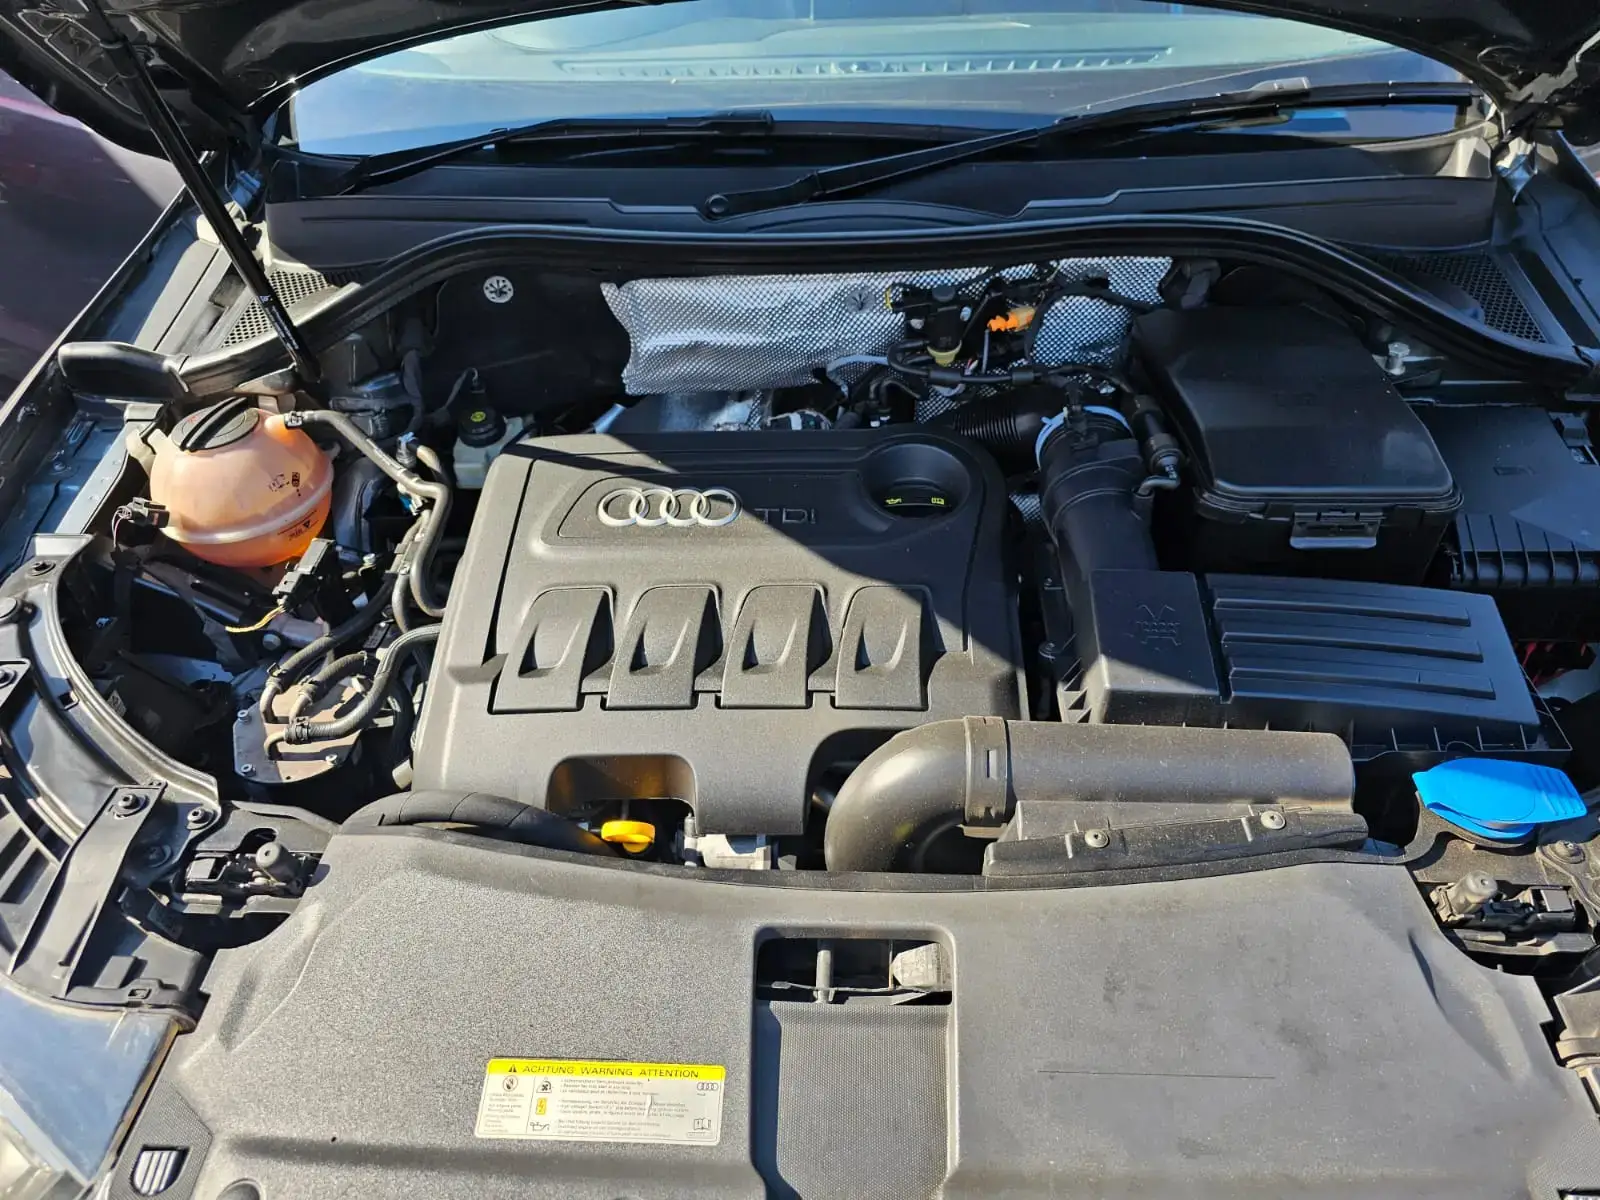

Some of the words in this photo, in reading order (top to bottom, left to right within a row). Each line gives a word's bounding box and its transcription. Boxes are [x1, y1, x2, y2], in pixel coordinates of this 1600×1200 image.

[754, 508, 816, 524] TDI
[522, 1065, 574, 1074] ACHTUNG
[580, 1066, 633, 1076] WARNING
[639, 1068, 699, 1078] ATTENTION
